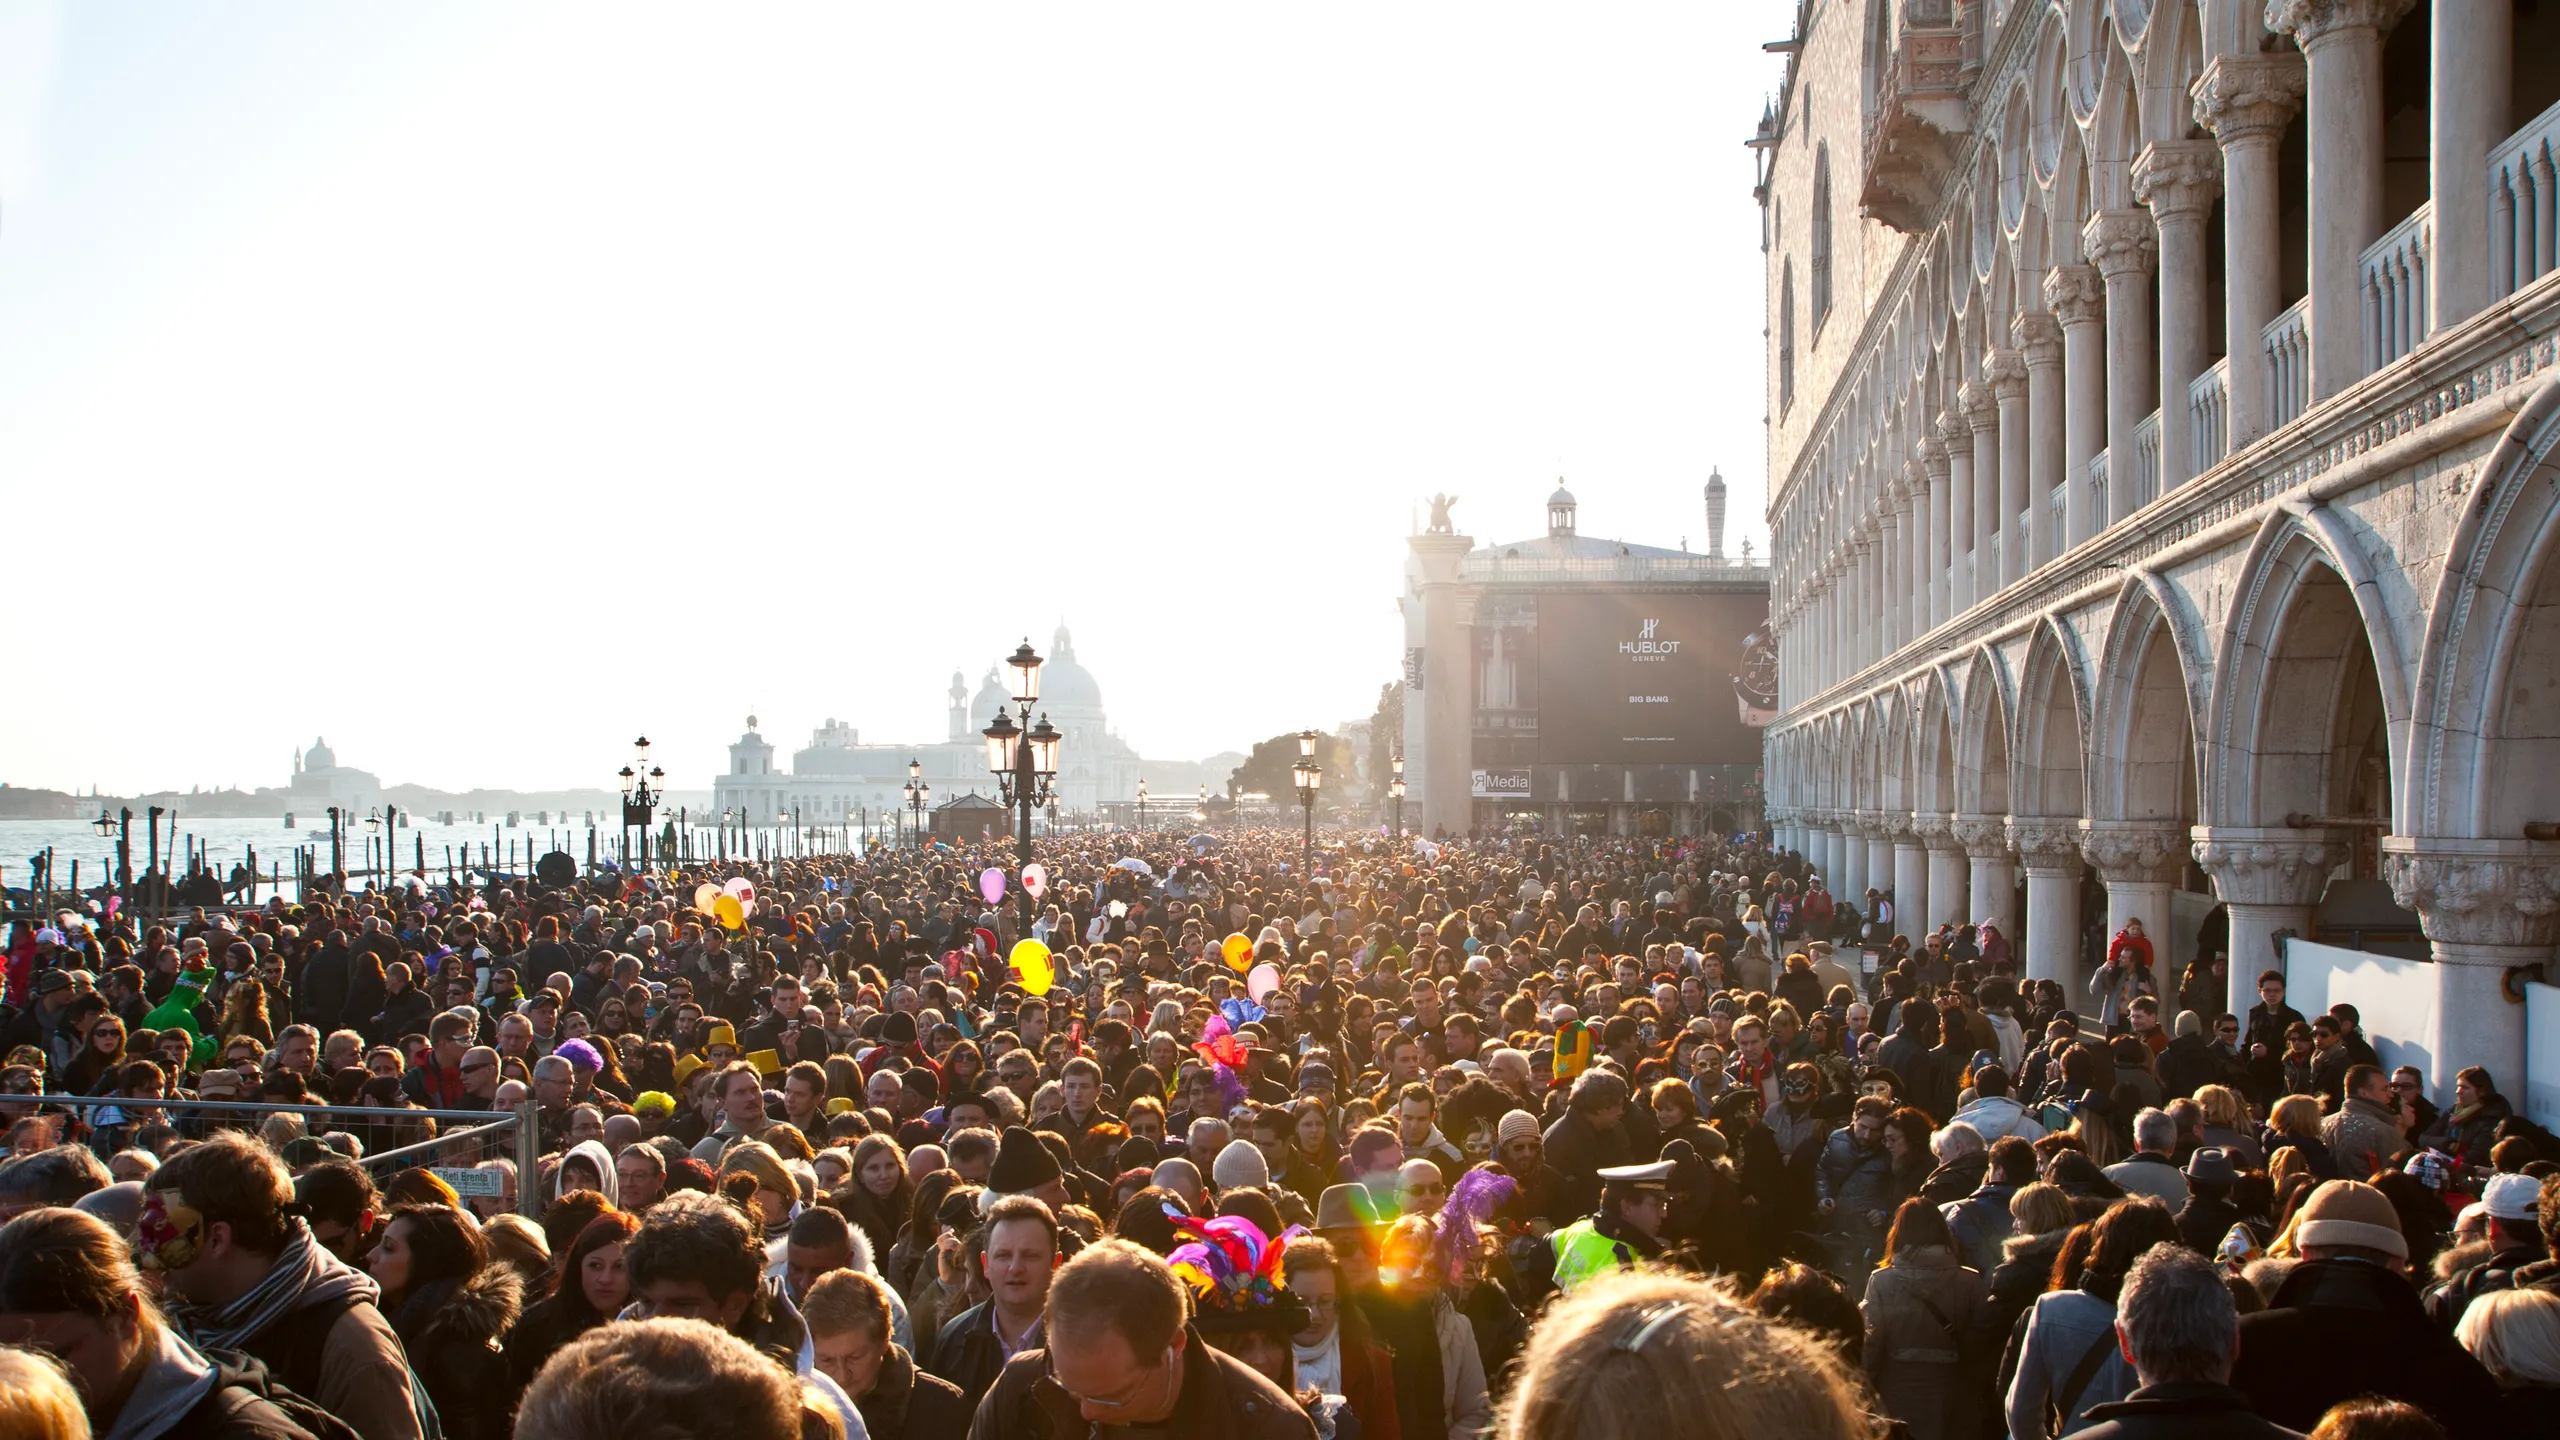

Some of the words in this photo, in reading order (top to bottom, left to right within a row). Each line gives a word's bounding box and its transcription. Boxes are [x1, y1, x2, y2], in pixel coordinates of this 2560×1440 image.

[1619, 641, 1681, 654] HUBLOT
[1629, 695, 1644, 703] BIG
[1645, 695, 1669, 703] BANG
[1486, 775, 1529, 788] Media
[443, 1170, 459, 1181] Reti
[461, 1171, 488, 1182] Brenta
